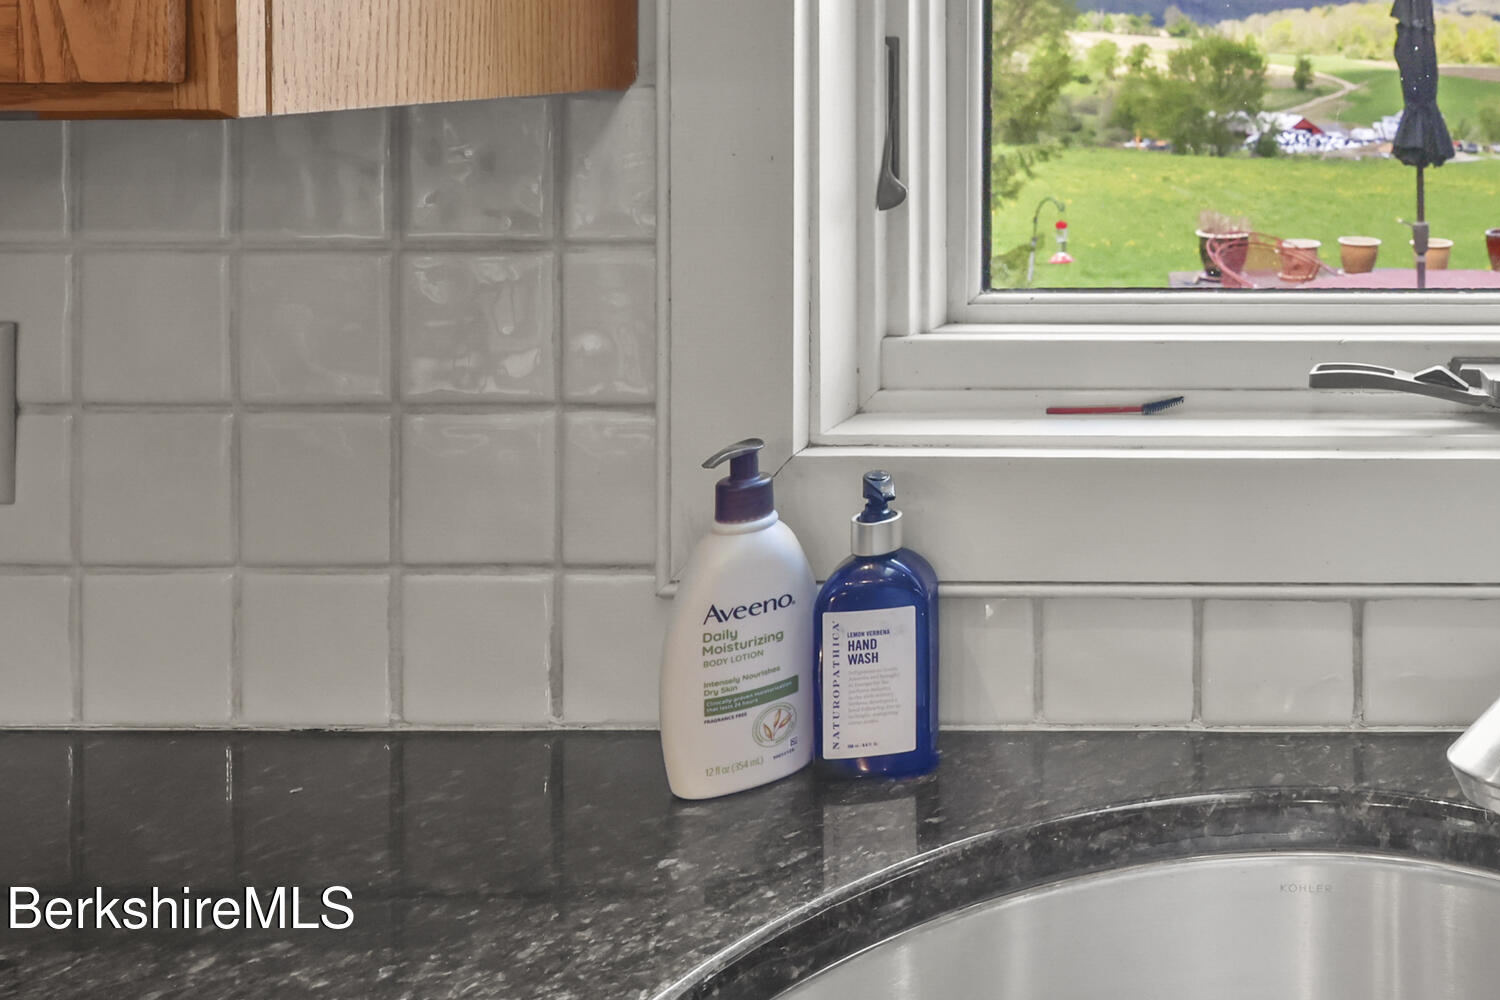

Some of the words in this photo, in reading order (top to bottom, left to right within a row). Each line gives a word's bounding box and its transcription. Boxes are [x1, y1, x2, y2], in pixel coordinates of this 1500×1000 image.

[703, 594, 793, 625] Aveeno
[703, 629, 738, 643] Daily
[702, 631, 784, 656] Moisturizing
[848, 639, 877, 652] HAND
[704, 658, 728, 668] BODY
[730, 650, 764, 663] LOTION
[848, 652, 879, 665] WASH
[704, 689, 719, 697] Dry
[721, 686, 738, 694] Skin
[832, 623, 840, 750] NATUROPATHICA
[705, 767, 714, 776] 12
[1280, 883, 1333, 894] KOHLER
